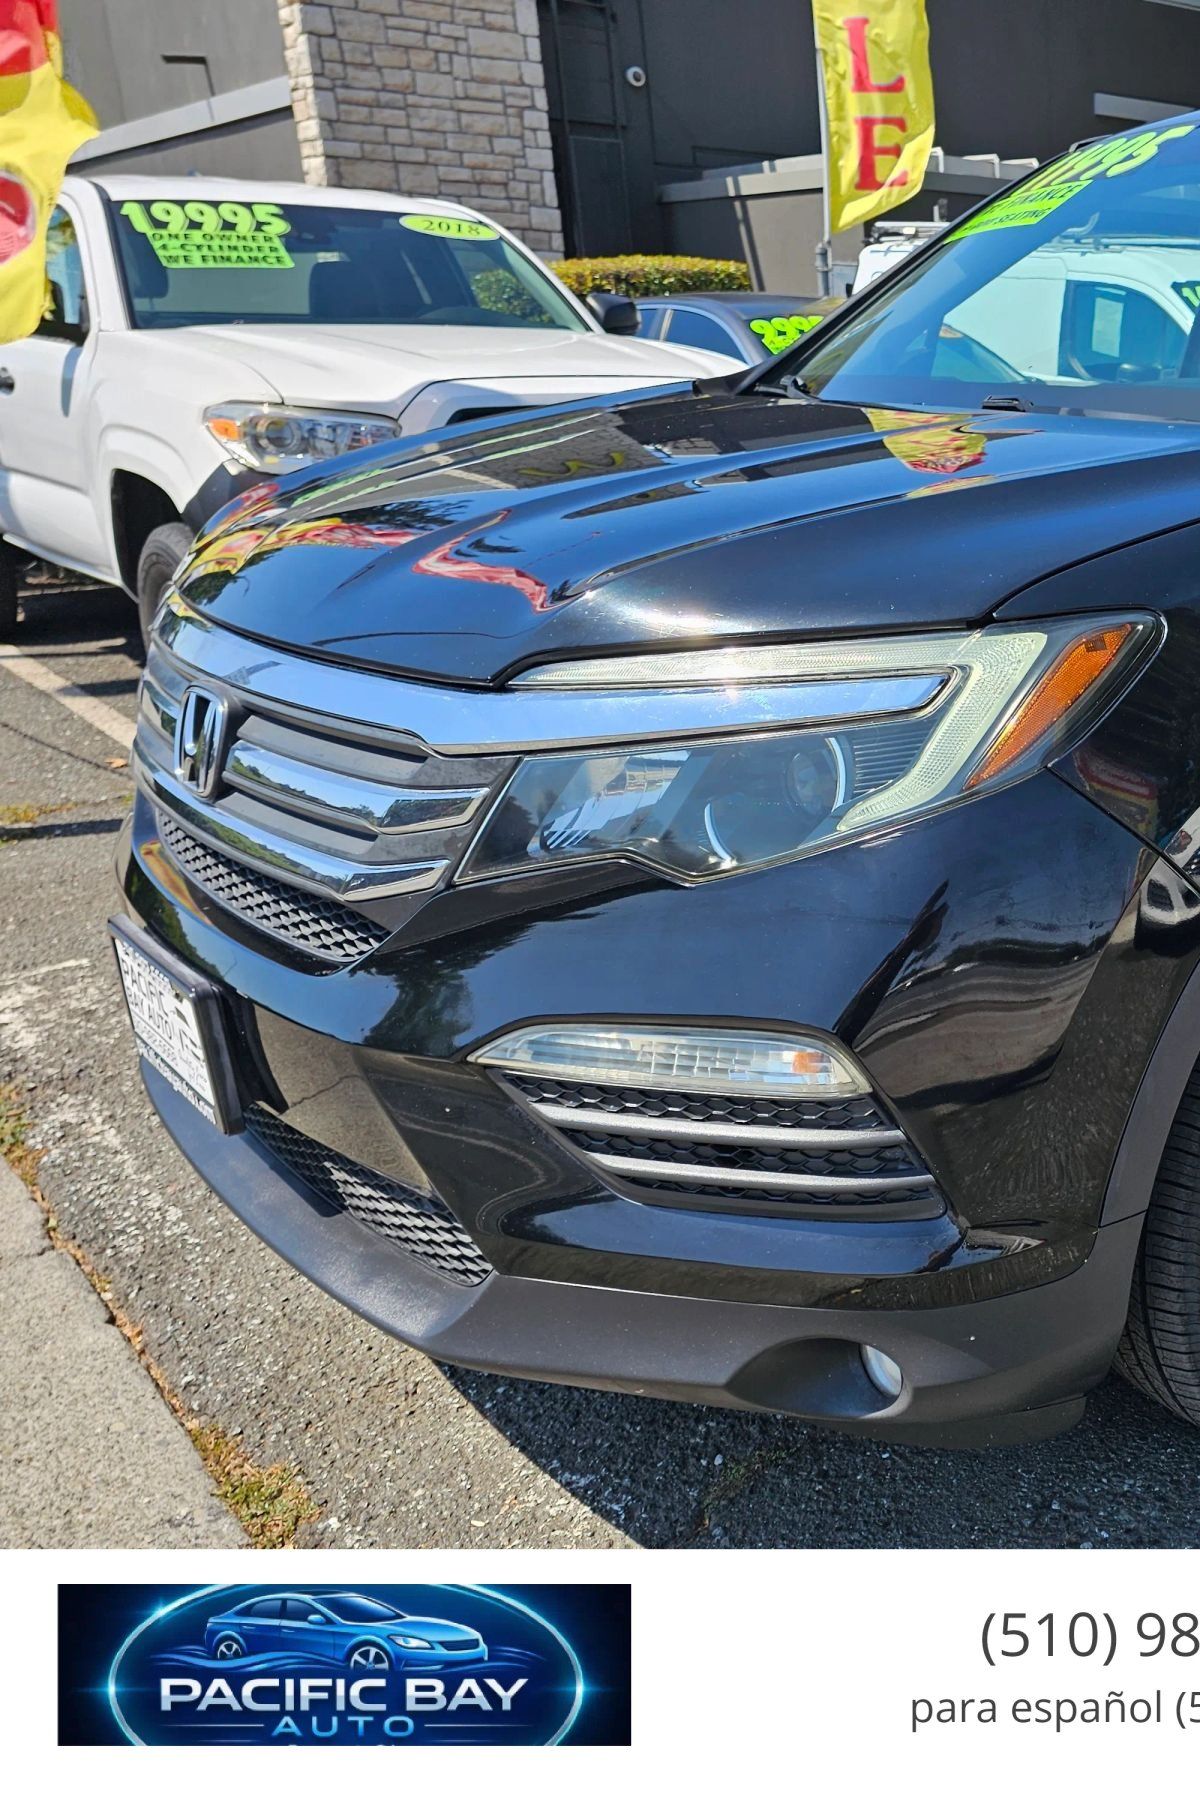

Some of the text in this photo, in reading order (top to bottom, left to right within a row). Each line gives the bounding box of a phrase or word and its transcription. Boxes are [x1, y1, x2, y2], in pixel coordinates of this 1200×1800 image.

[120, 201, 292, 237] 19995
[422, 219, 481, 236] 2018
[152, 232, 274, 243] ONE OWNER
[158, 243, 279, 252] 4-CYLINDER
[164, 255, 285, 265] WE FINANCE
[121, 957, 170, 1018] PACIFIC
[147, 1003, 174, 1041] AUTO
